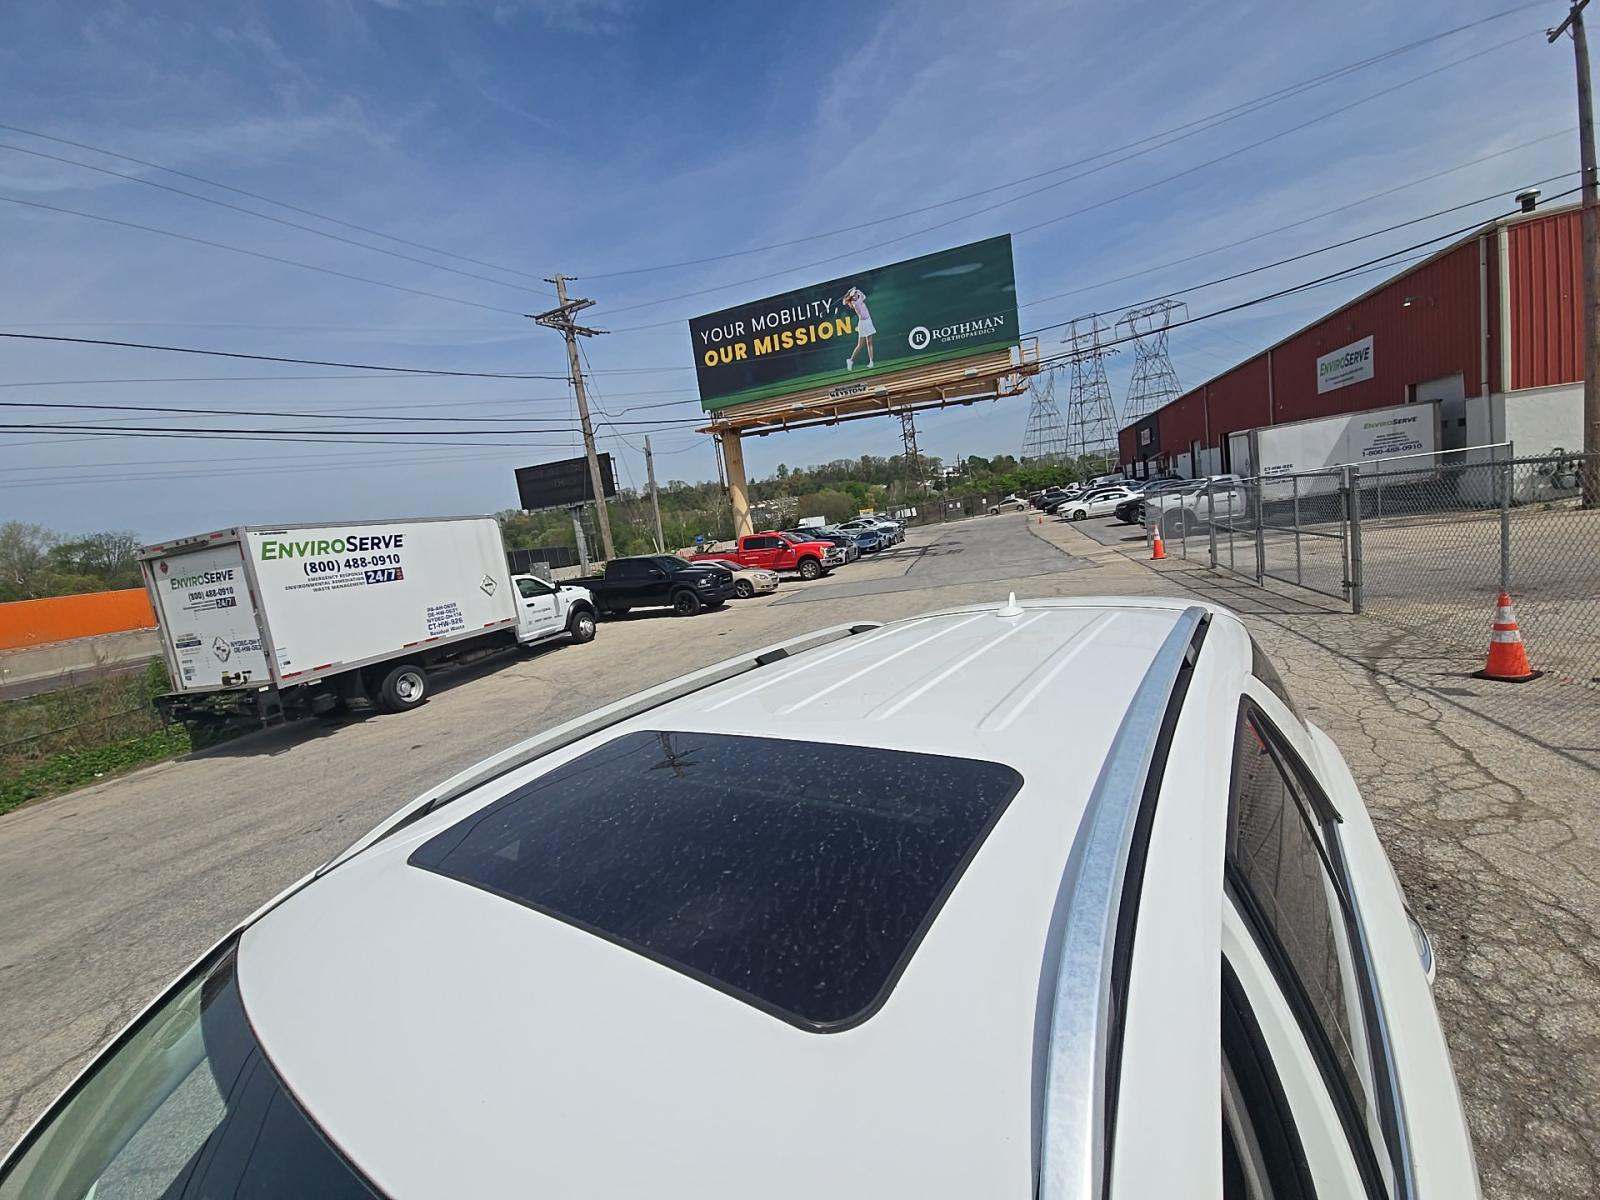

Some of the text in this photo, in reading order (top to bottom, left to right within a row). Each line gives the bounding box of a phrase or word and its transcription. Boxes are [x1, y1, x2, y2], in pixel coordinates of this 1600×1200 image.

[701, 298, 839, 345] YOUR MOBILITY,
[932, 315, 1004, 339] ROTHMAN
[704, 316, 852, 367] OUR MISSION
[941, 328, 995, 342] ORTHOPAEDICS
[261, 533, 404, 561] ENVIROSERVE
[303, 553, 401, 577] (800) 488-0910
[366, 568, 396, 583] 24/7
[188, 587, 234, 601] (800) 488-0910
[216, 597, 232, 608] 24/7
